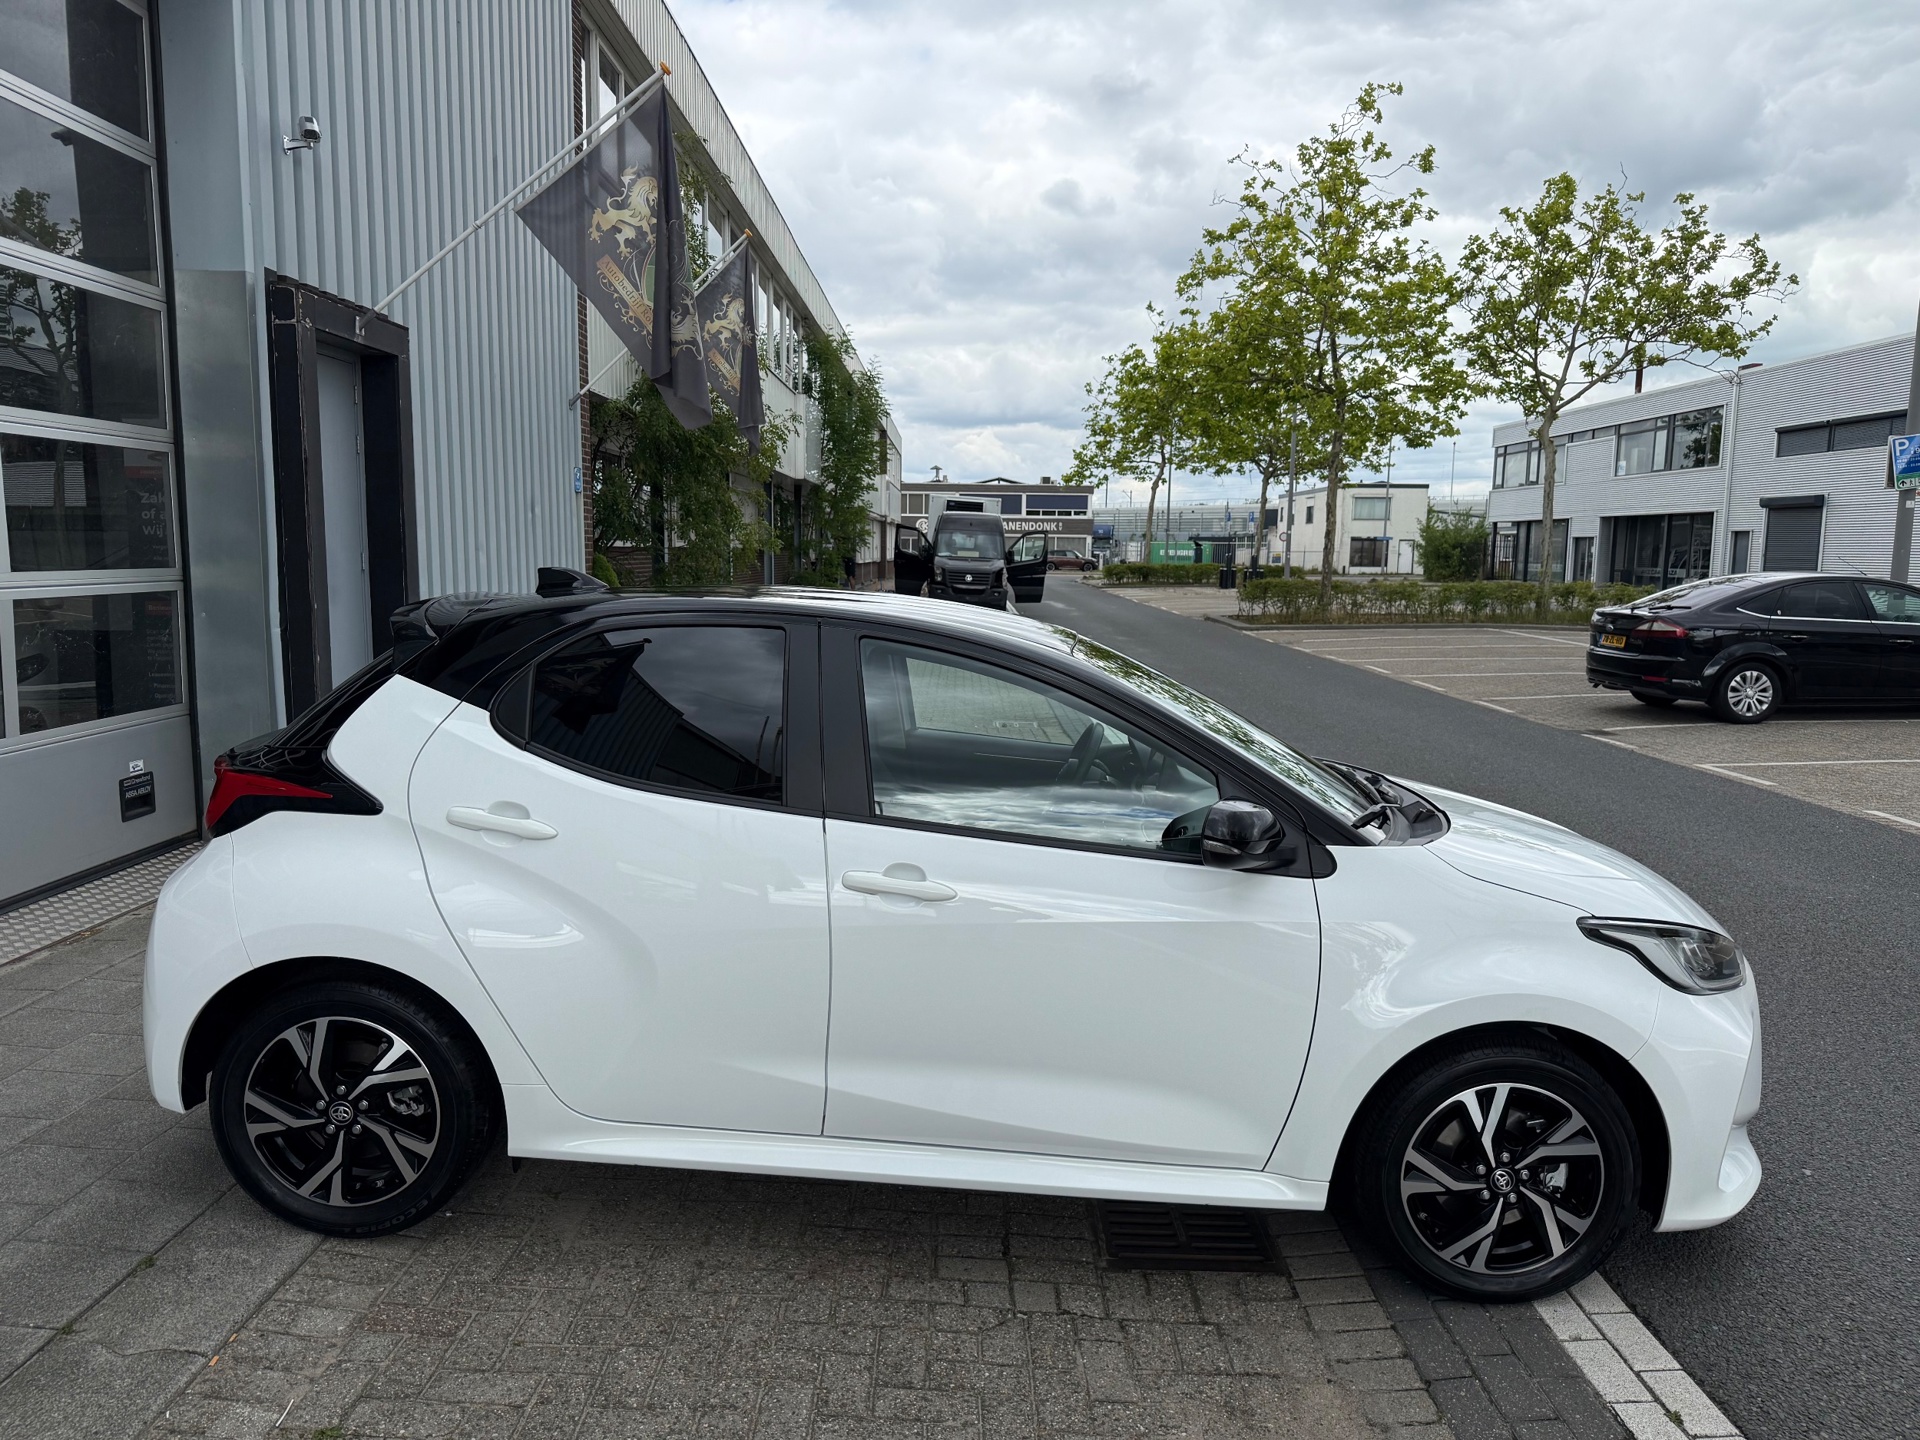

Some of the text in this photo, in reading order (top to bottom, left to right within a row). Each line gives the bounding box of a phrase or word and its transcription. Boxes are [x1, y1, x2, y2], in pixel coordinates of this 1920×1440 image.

[601, 260, 643, 309] Autobedrijf
[1895, 439, 1909, 456] P
[141, 508, 156, 519] of
[142, 525, 163, 538] Wij
[126, 785, 151, 799] ASSA ABLOY
